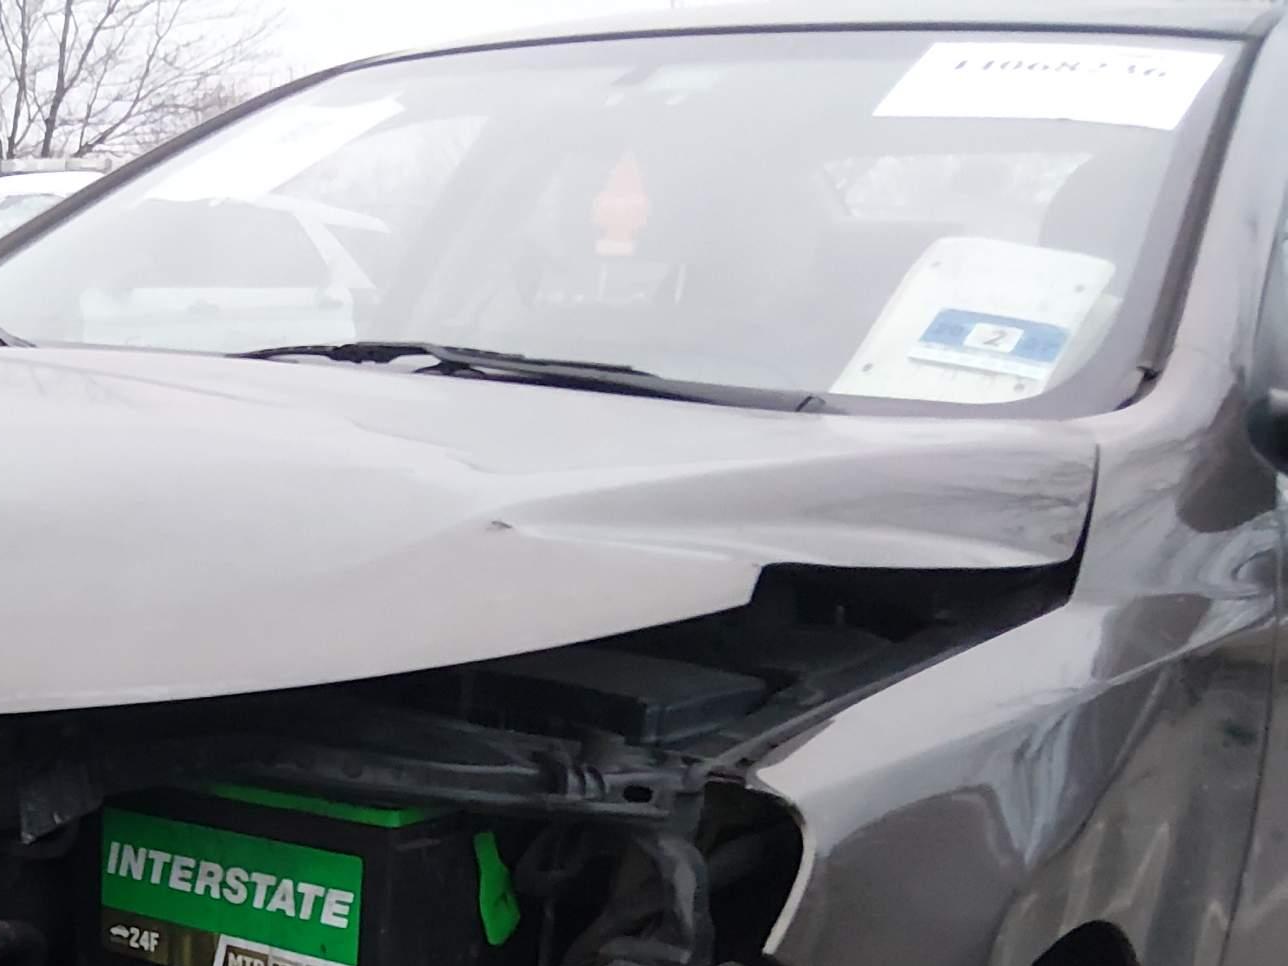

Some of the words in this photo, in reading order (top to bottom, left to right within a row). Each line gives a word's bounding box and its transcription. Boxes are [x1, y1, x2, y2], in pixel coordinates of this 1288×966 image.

[982, 328, 1007, 347] 2
[106, 840, 356, 929] INTERSTATE
[128, 927, 160, 953] 24F
